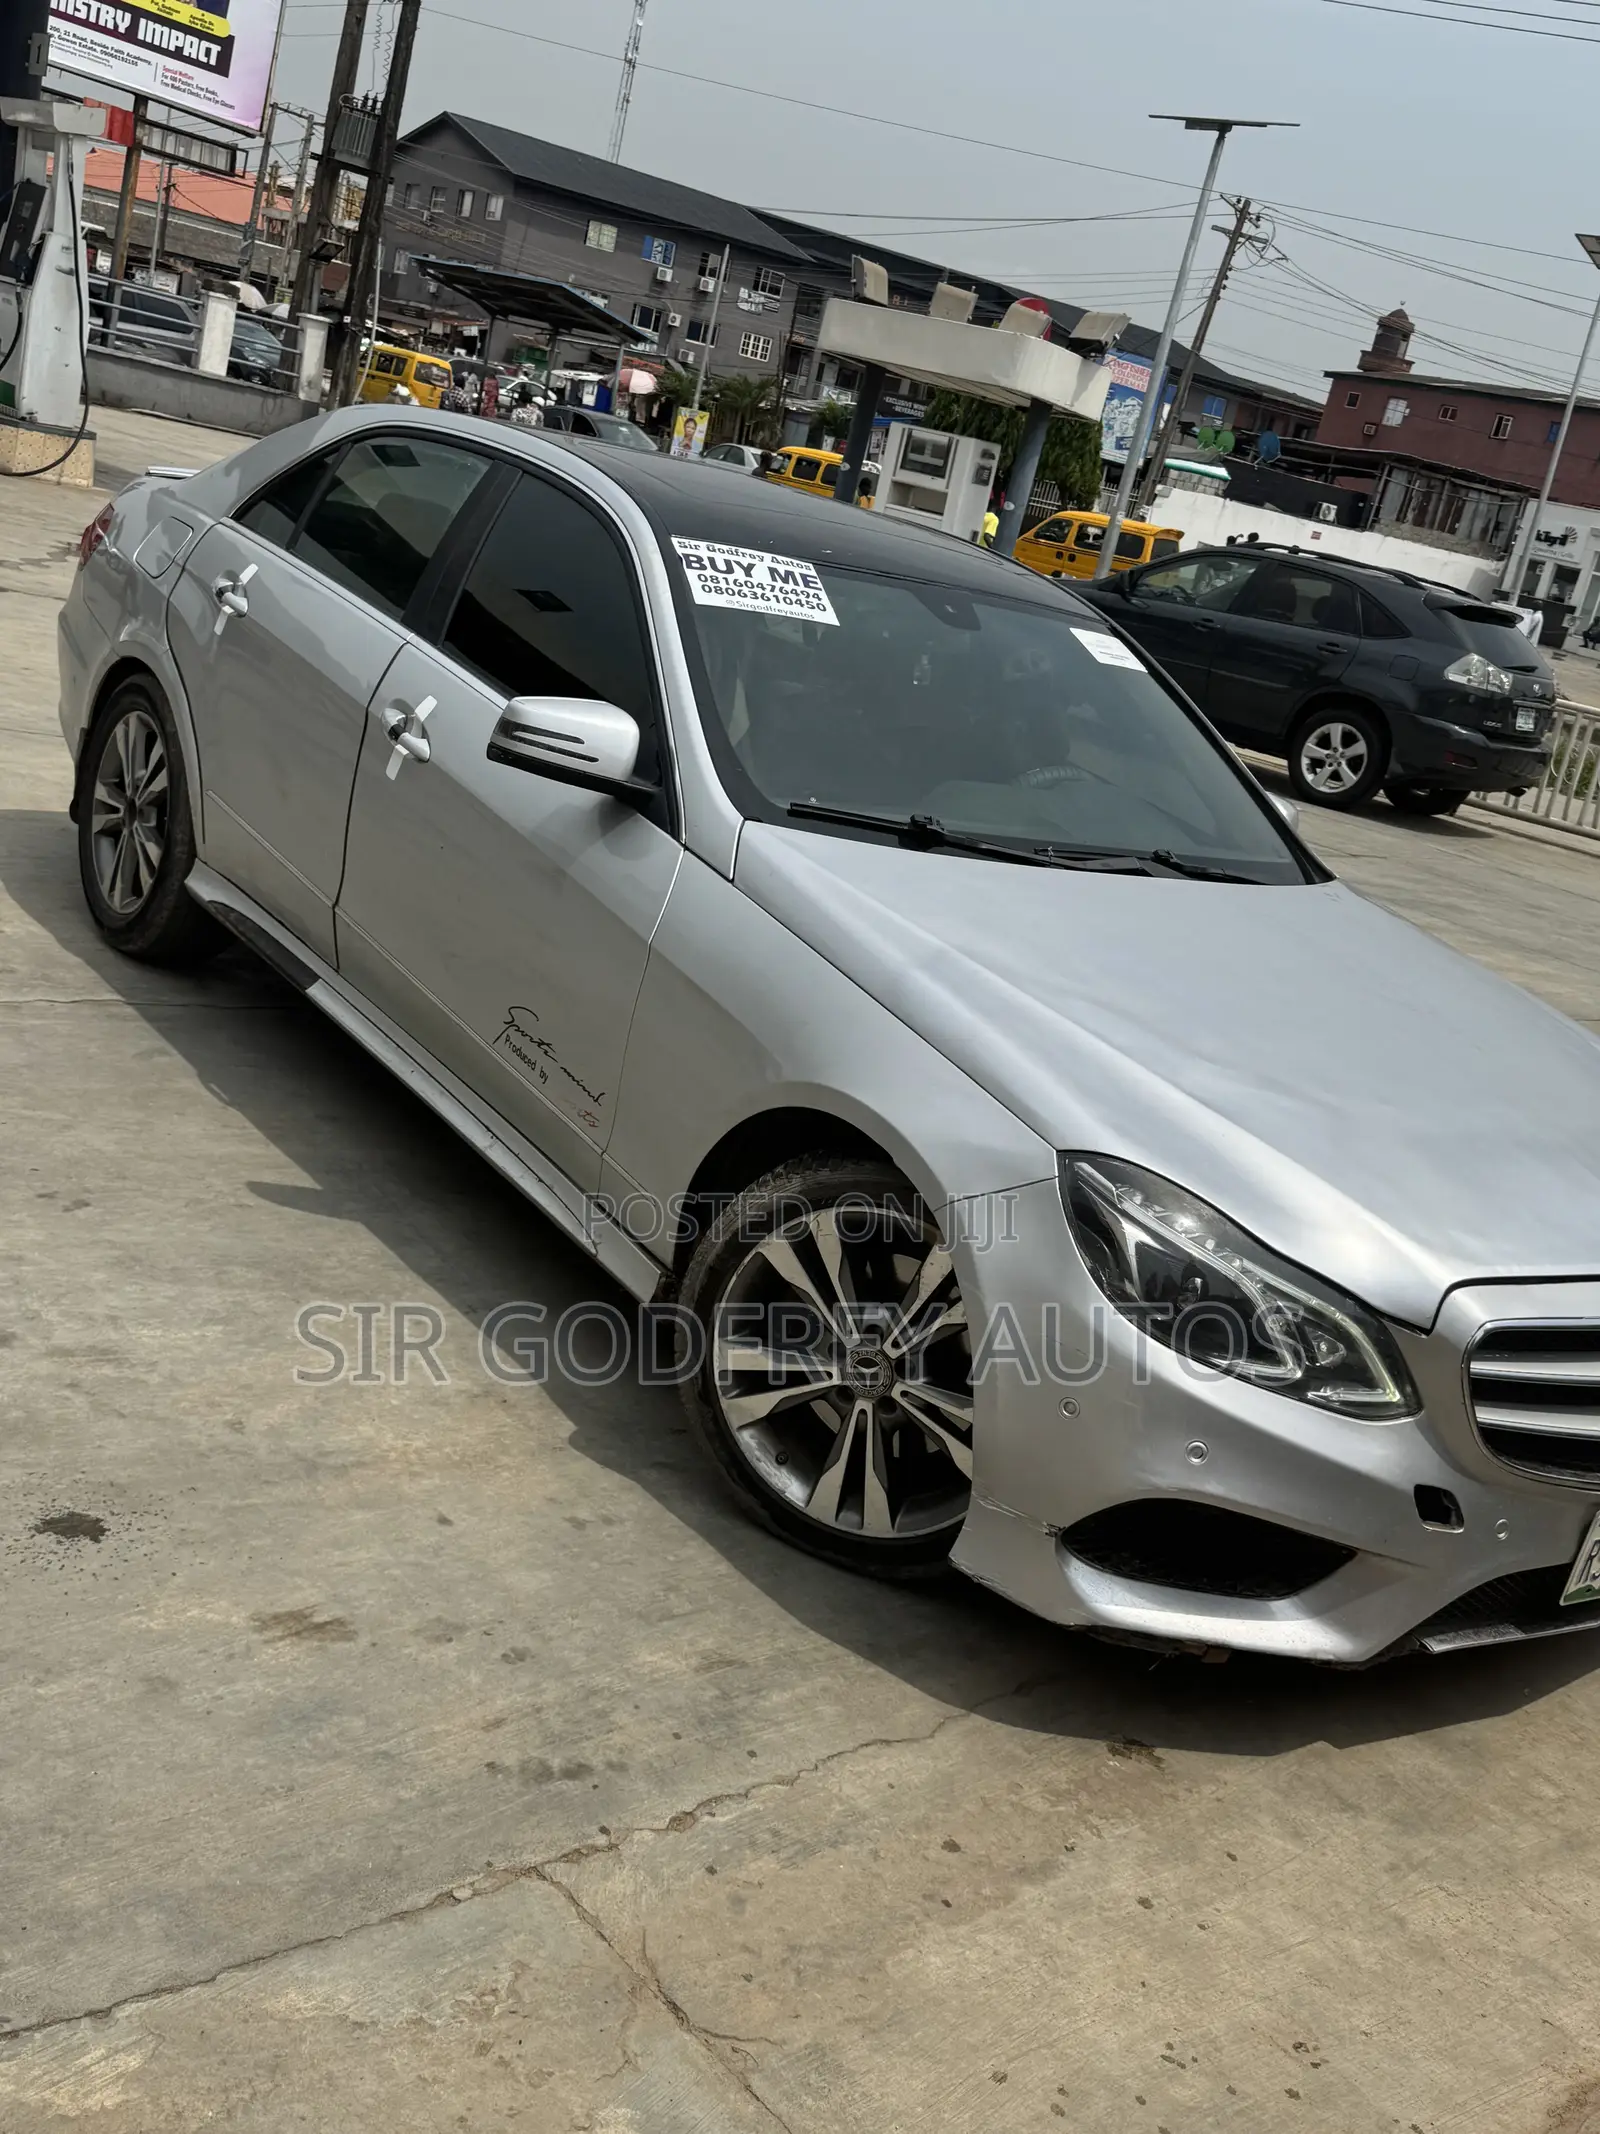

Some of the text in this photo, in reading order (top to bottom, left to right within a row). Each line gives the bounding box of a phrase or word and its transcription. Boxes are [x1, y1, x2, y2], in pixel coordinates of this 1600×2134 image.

[72, 33, 88, 44] Road,
[90, 39, 109, 50] Beside
[110, 45, 125, 55] Faith
[126, 51, 152, 66] Academy,
[137, 18, 222, 66] IMPACT
[1112, 368, 1148, 382] COLDROO
[895, 406, 924, 417] BEVERAGES
[677, 540, 812, 571] Sir Godfrey Autos
[682, 553, 823, 592] BUY ME
[698, 573, 822, 602] 08160476494
[701, 584, 827, 612] 08063610450
[504, 1034, 549, 1084] Produced by
